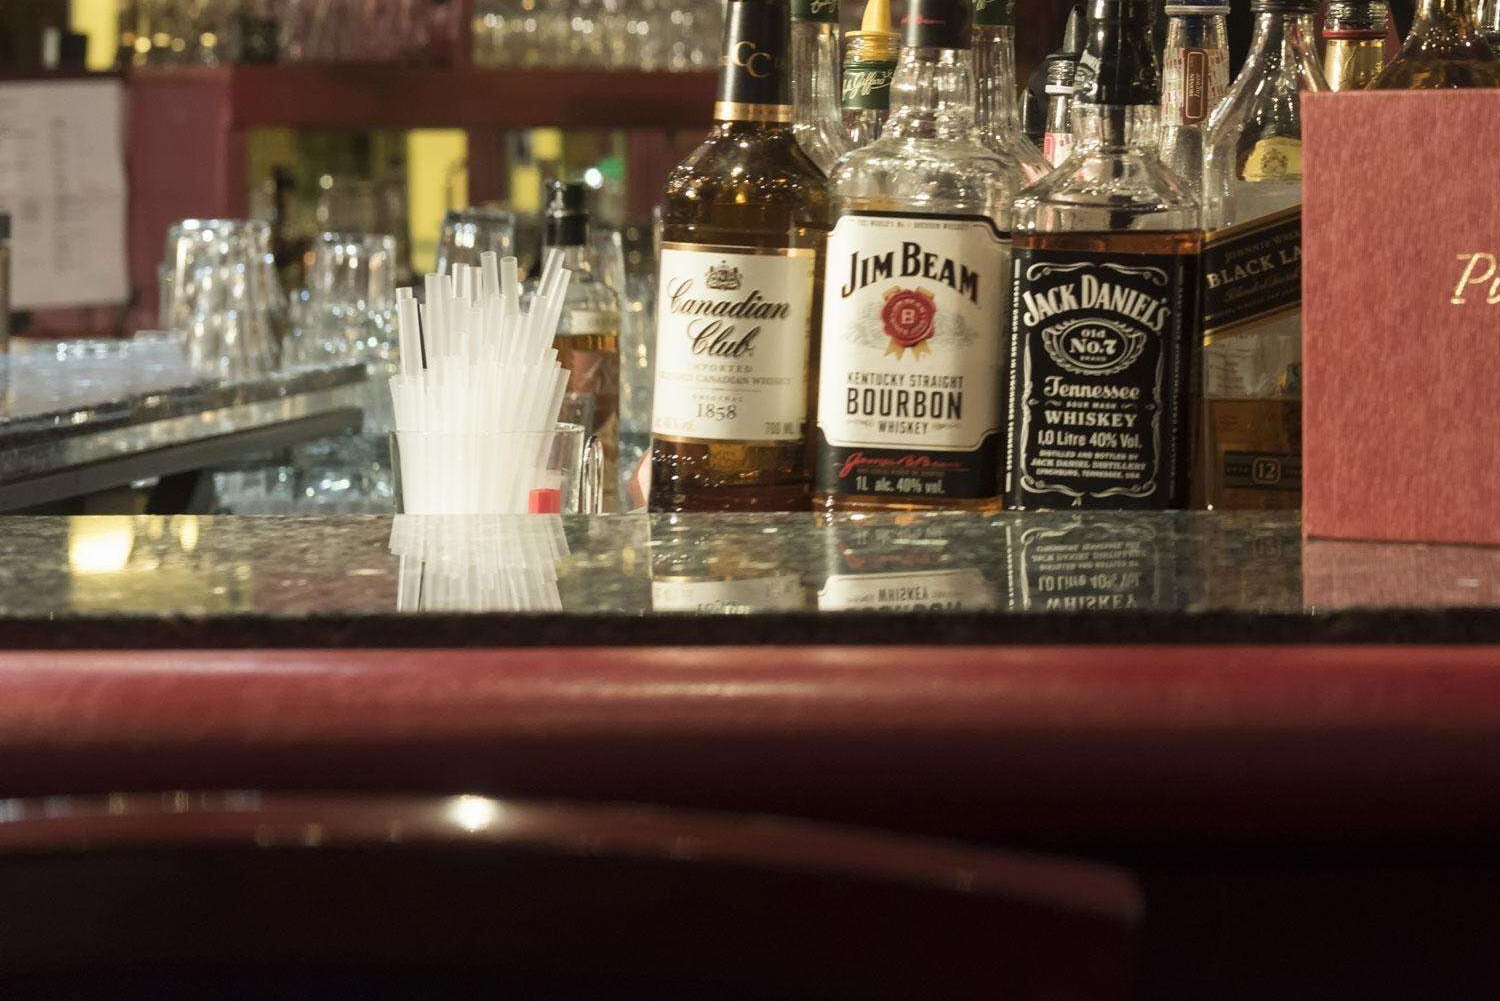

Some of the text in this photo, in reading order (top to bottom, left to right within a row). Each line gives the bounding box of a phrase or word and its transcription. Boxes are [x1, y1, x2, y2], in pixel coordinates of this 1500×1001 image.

[841, 241, 981, 304] JIM BEAM
[1206, 253, 1276, 290] BLACK
[667, 277, 791, 320] Canadian
[1022, 282, 1080, 327] JACK
[1081, 274, 1172, 332] DANIEL'S
[687, 319, 762, 358] Club
[1080, 328, 1107, 339] Old
[848, 372, 965, 389] KENTUCKY STRAIGHT
[1043, 375, 1141, 400] Tennessee
[696, 403, 738, 421] 1858
[846, 387, 963, 420] BOURBON
[878, 420, 929, 435] WHISKEY
[1044, 410, 1139, 428] WHISKEY
[1056, 430, 1087, 447] Litre
[1089, 431, 1118, 448] 40%
